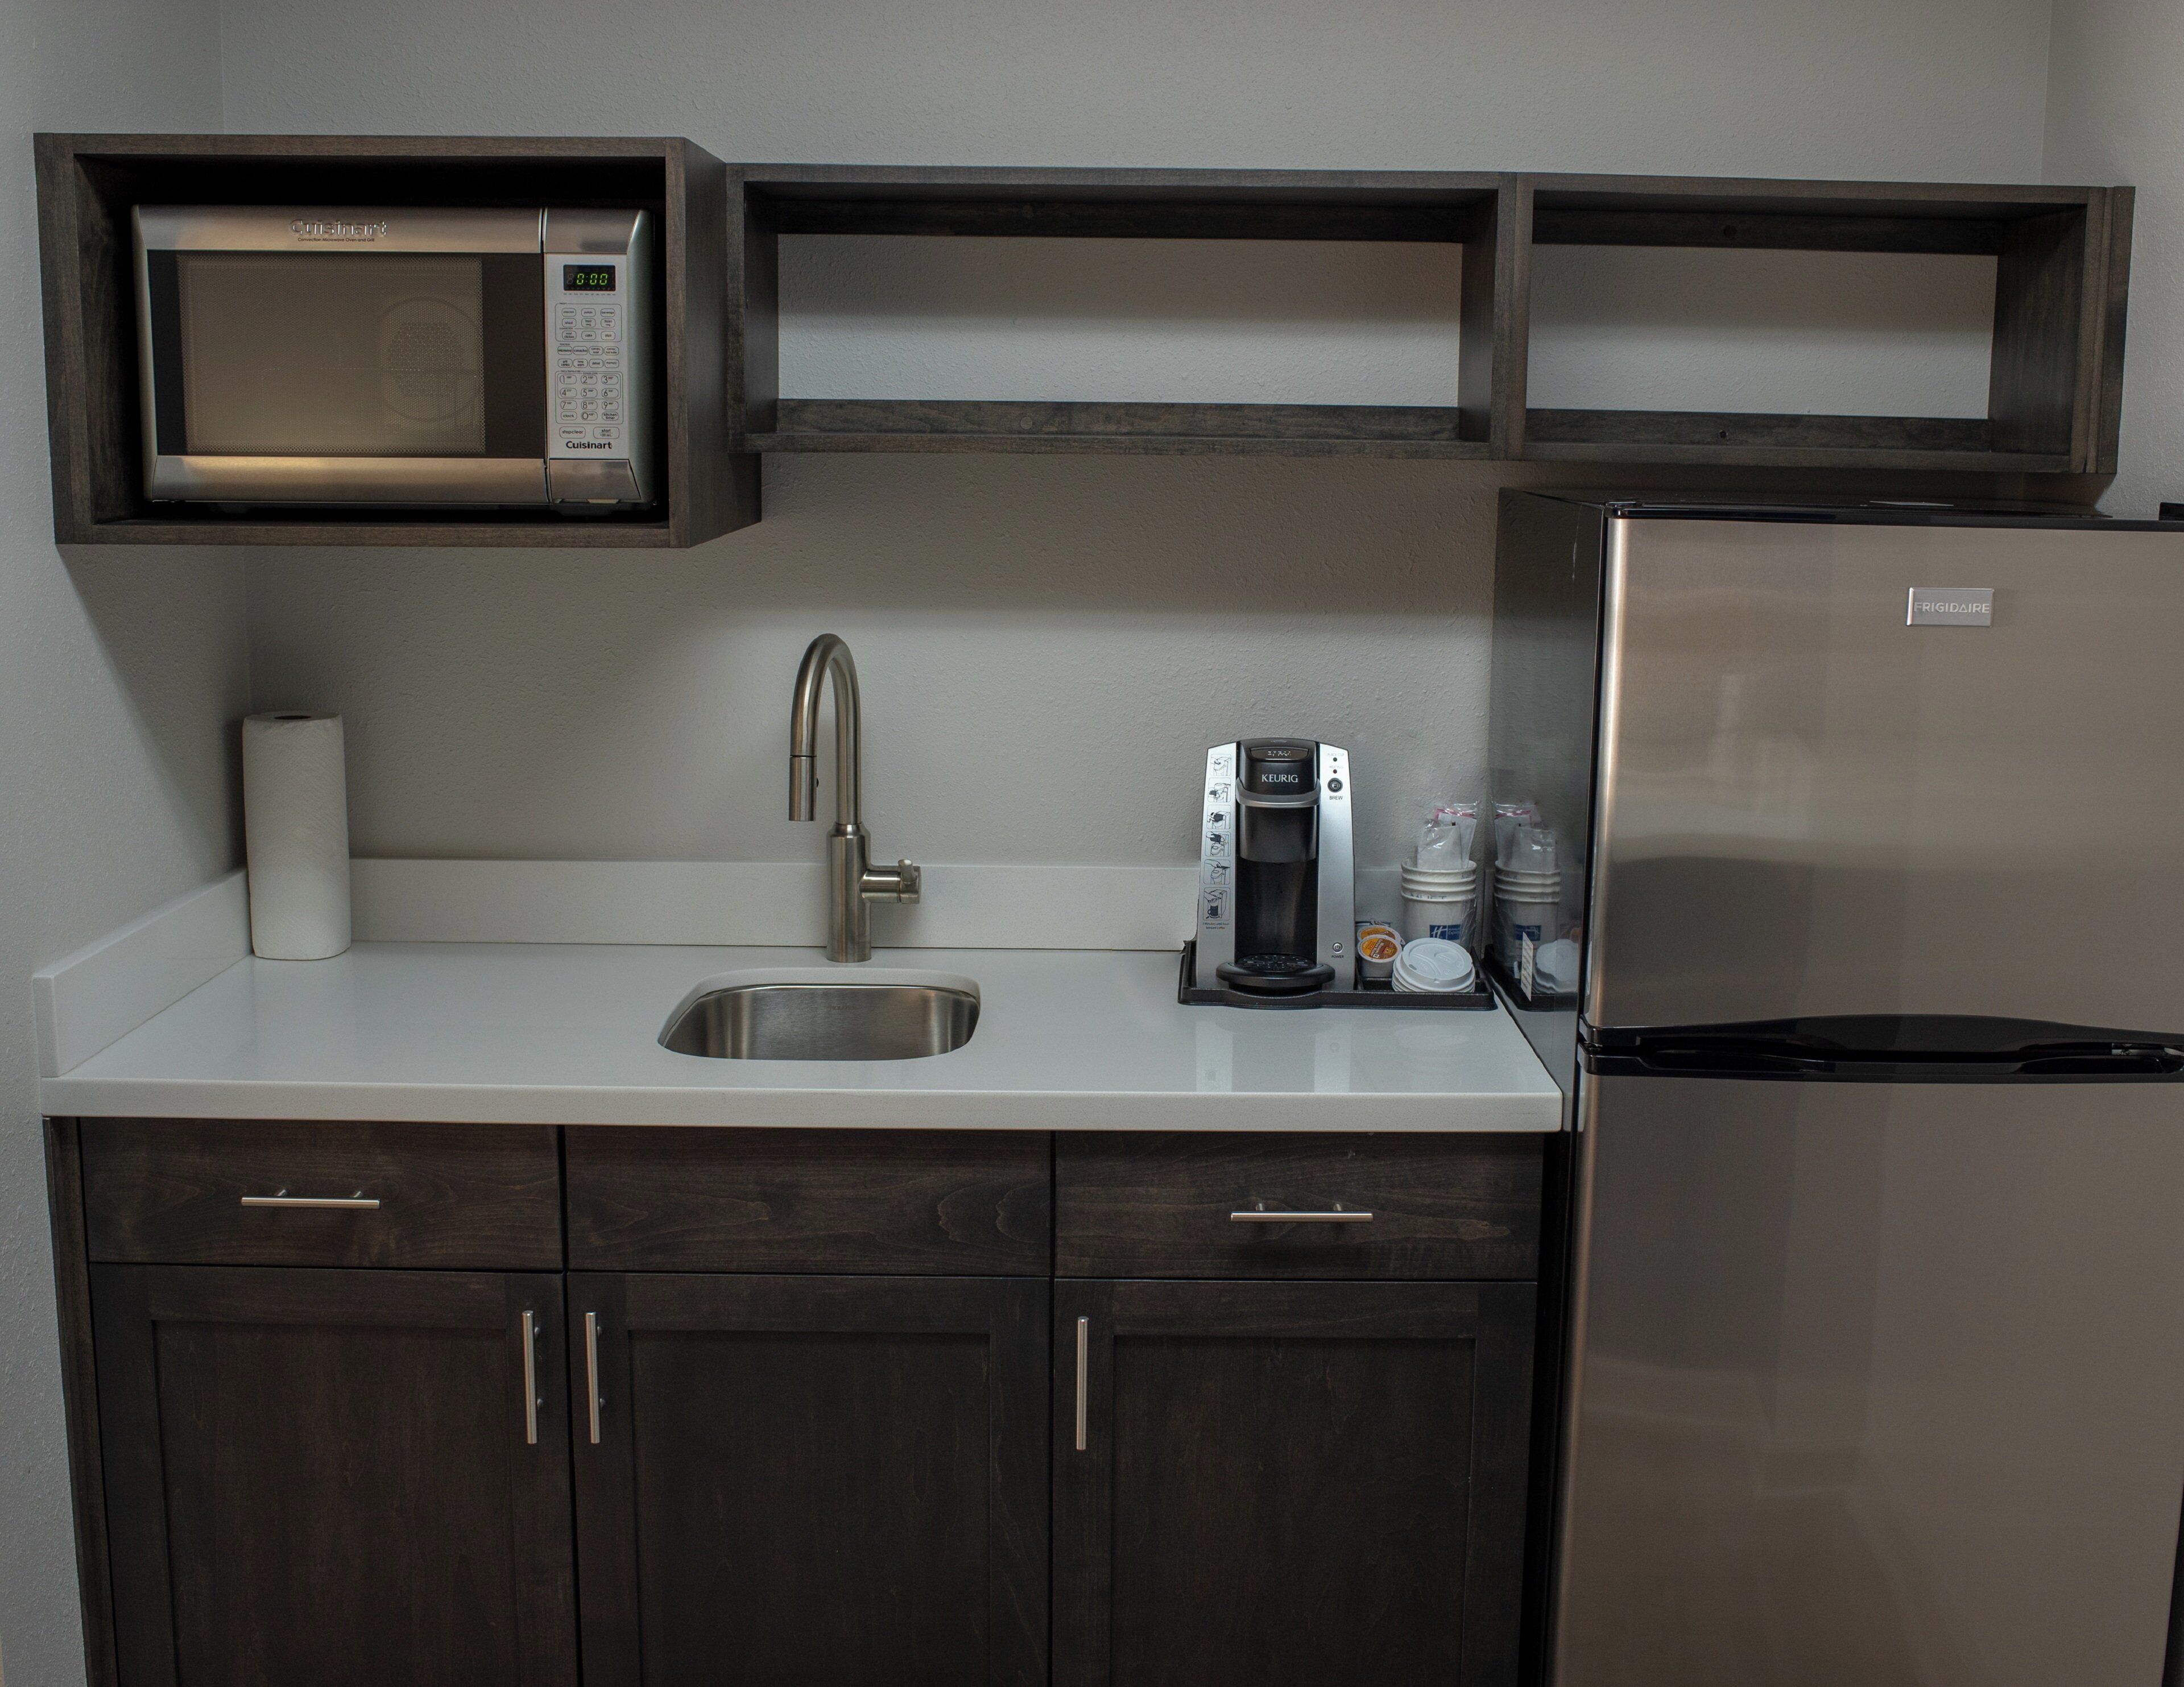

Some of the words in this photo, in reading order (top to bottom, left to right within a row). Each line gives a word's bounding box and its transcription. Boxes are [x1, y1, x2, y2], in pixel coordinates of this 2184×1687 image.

[291, 219, 387, 237] Cuisinart
[577, 274, 608, 285] 0:00
[1914, 602, 1989, 613] FRIGIDAIRE
[1261, 774, 1298, 783] KEURIG
